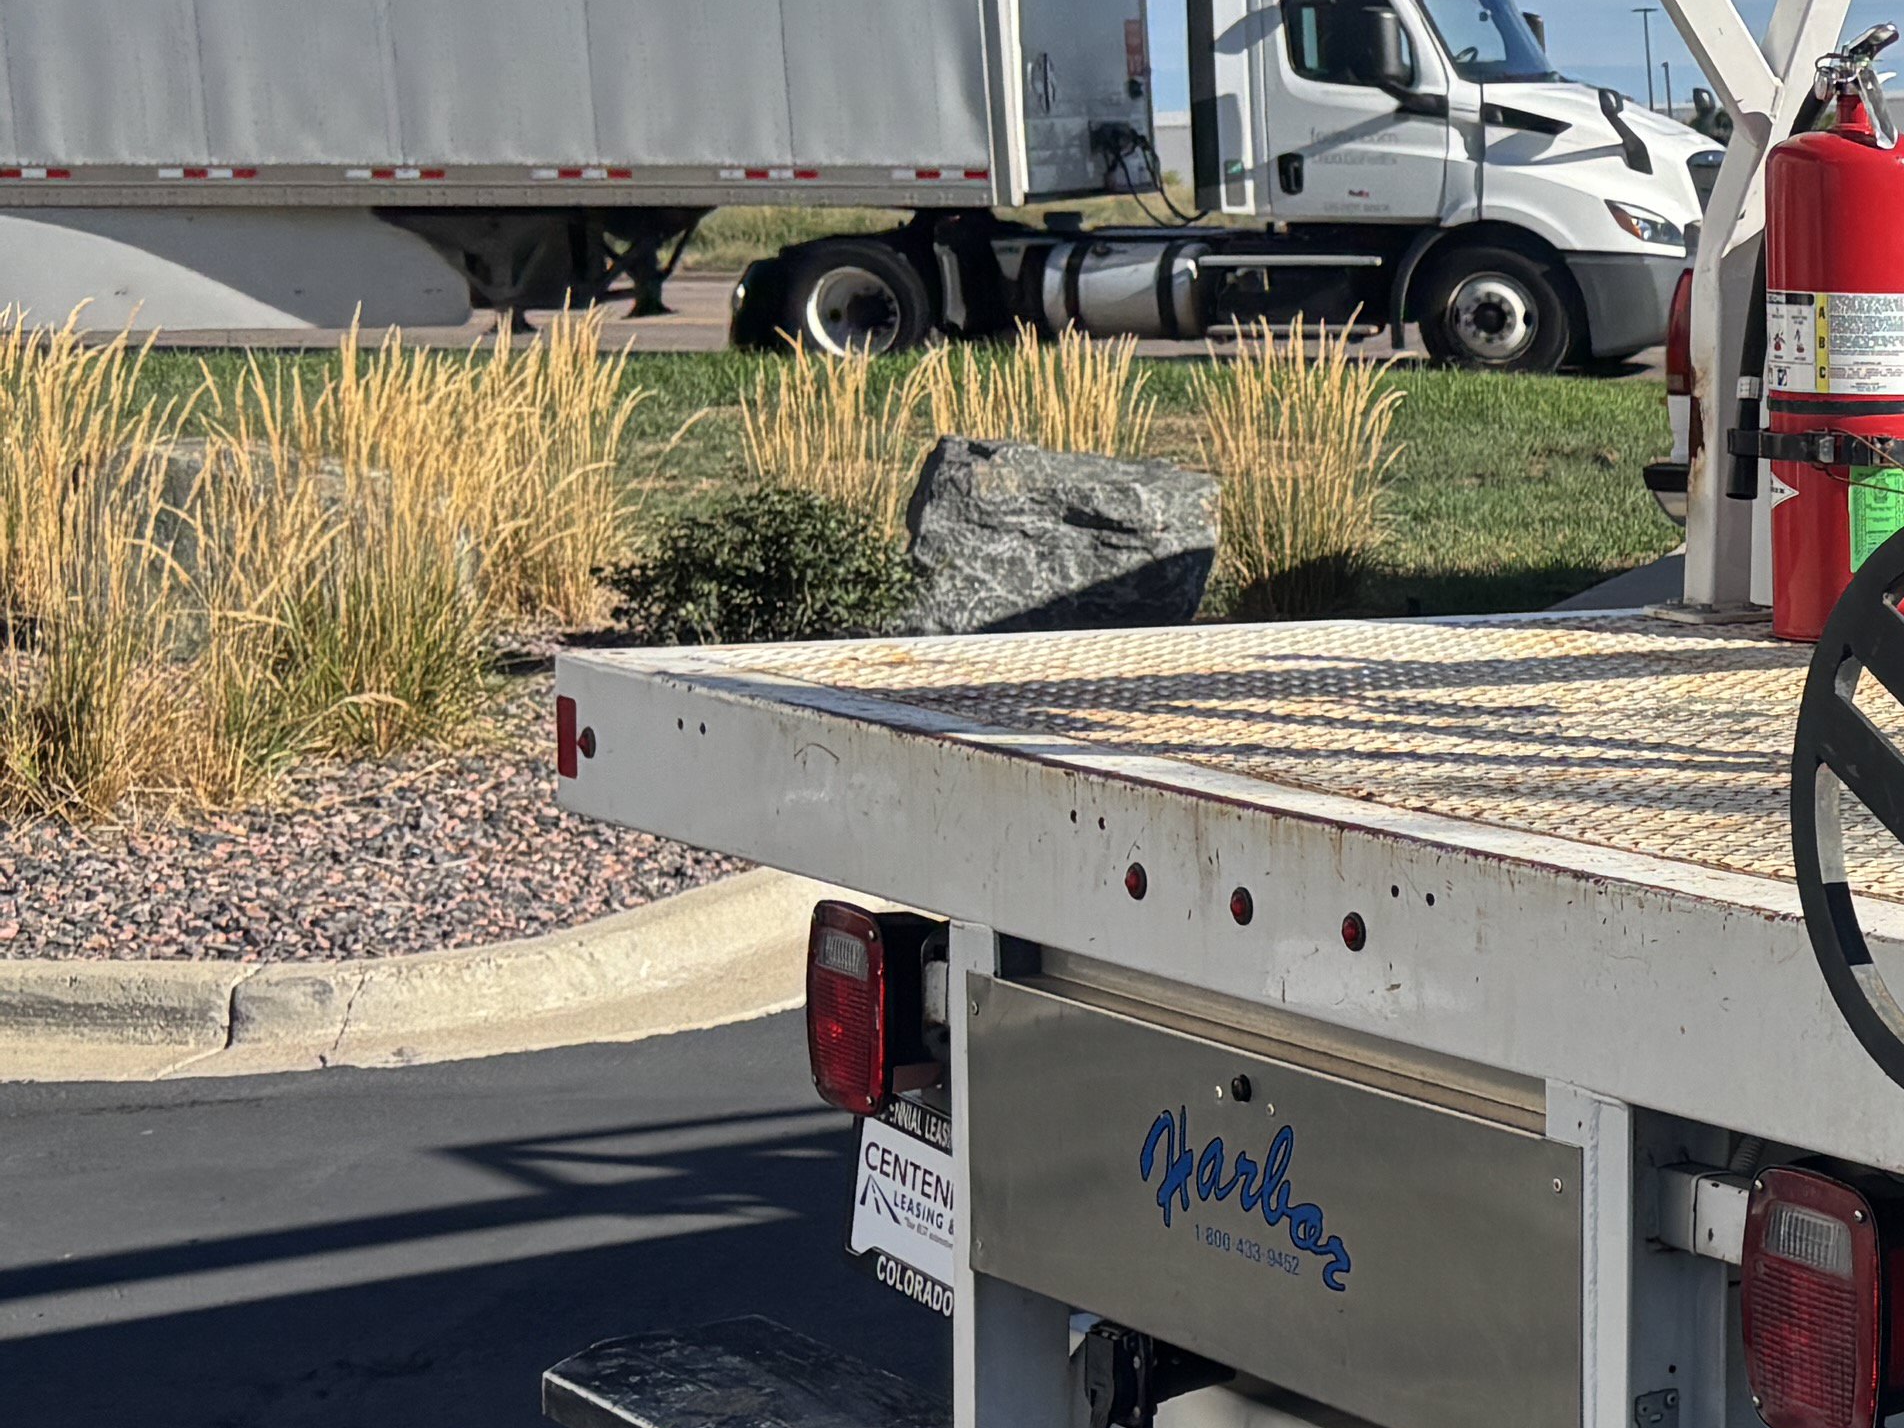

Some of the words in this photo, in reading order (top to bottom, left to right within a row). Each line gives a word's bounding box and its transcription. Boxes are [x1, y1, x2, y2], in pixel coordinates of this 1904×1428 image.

[1818, 307, 1826, 320] A
[1818, 336, 1826, 349] B
[1818, 366, 1826, 379] C
[894, 1190, 944, 1230] LEASING
[1140, 1105, 1351, 1292] Harbor
[876, 1255, 954, 1317] COLORADO
